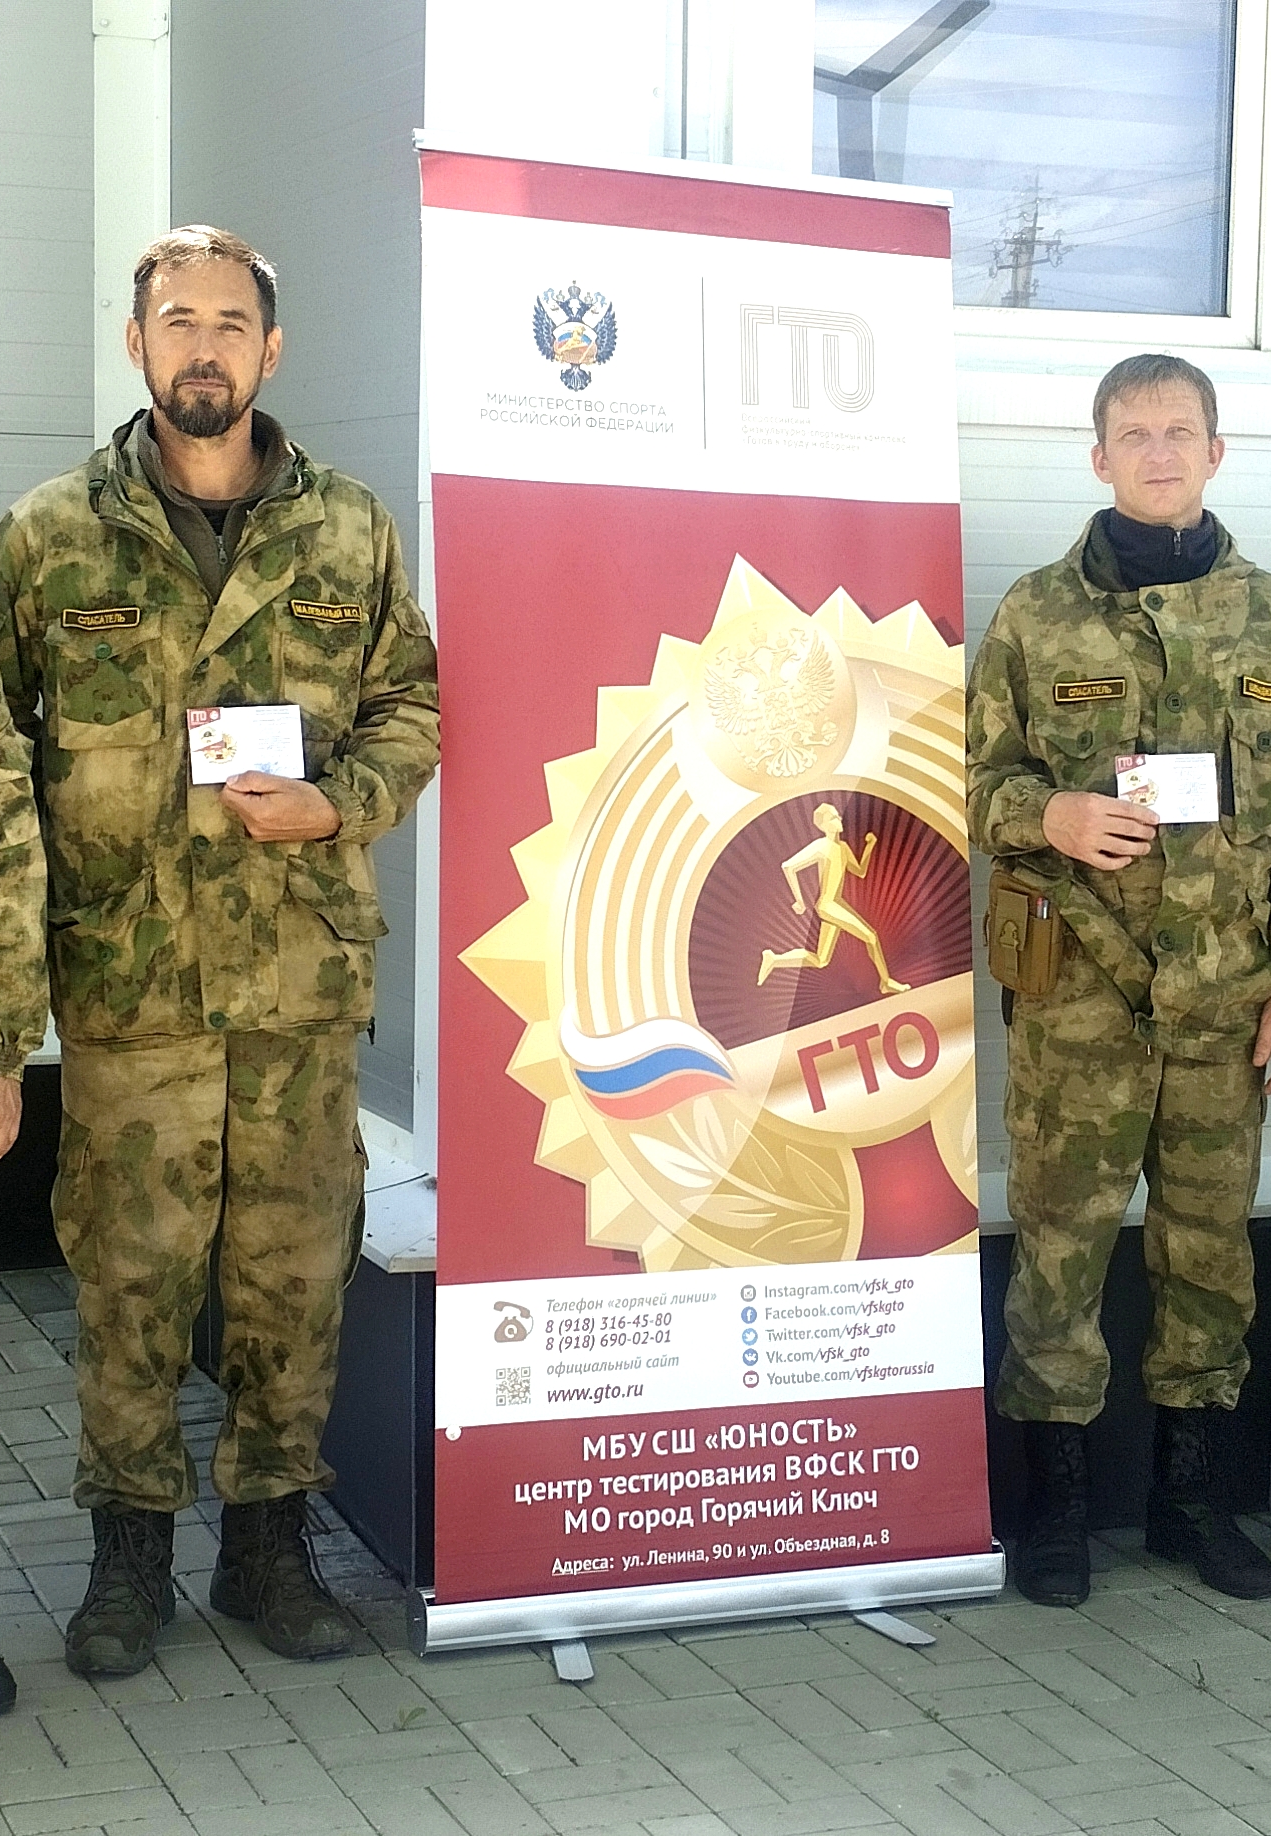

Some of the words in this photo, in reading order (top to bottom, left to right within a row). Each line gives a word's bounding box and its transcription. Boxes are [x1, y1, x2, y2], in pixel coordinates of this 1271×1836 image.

[739, 303, 875, 413] ГТО
[486, 392, 605, 413] МИНИСТЕРСТВО
[609, 401, 667, 417] СПОРТА
[480, 408, 581, 428] РОССИЙСКОЙ
[586, 416, 674, 434] ФЕДЕРАЦИИ
[78, 613, 126, 625] СПАСАТЕЛЬ
[1068, 685, 1113, 697] СПАСАТЕЛЬ
[796, 1011, 940, 1113] ГТО
[764, 1278, 914, 1300] Instagram.com/vfsk_gto
[546, 1298, 603, 1314] Телефон
[608, 1292, 667, 1311] «горячей
[670, 1292, 717, 1306] линии»
[764, 1300, 904, 1321] Facebook.com/vfskgto
[545, 1319, 555, 1334] 8
[558, 1317, 595, 1336] (918)
[600, 1312, 672, 1331] 316-45-80
[765, 1322, 896, 1342] Twitter.com/vfsk_gto
[545, 1337, 555, 1351] 8
[558, 1334, 595, 1353] (918)
[600, 1329, 672, 1348] 690-02-01
[546, 1356, 642, 1378] официальный
[646, 1354, 679, 1369] сайт
[766, 1346, 870, 1364] Vk.com/vfsk_gto
[766, 1361, 935, 1386] Youtube.com/vfskgtorussia
[547, 1383, 644, 1404] www.gto.ru
[583, 1431, 647, 1462] МБУ
[652, 1428, 696, 1456] СШ
[705, 1417, 858, 1451] «ЮНОСТЬ»
[514, 1477, 593, 1505] центр
[599, 1463, 777, 1497] тестирования
[785, 1449, 865, 1481] ВФСК
[872, 1445, 920, 1473] ГТО
[564, 1506, 611, 1535] МО
[618, 1505, 695, 1535] город
[701, 1490, 804, 1528] Горячий
[811, 1487, 878, 1514] Ключ
[552, 1556, 614, 1577] Адреса:
[622, 1556, 645, 1572] ул.
[647, 1549, 710, 1566] Ленина,
[712, 1543, 733, 1560] 90
[736, 1545, 747, 1558] и
[774, 1535, 861, 1554] Объездная,
[862, 1534, 878, 1548] д.
[880, 1528, 890, 1544] 8
